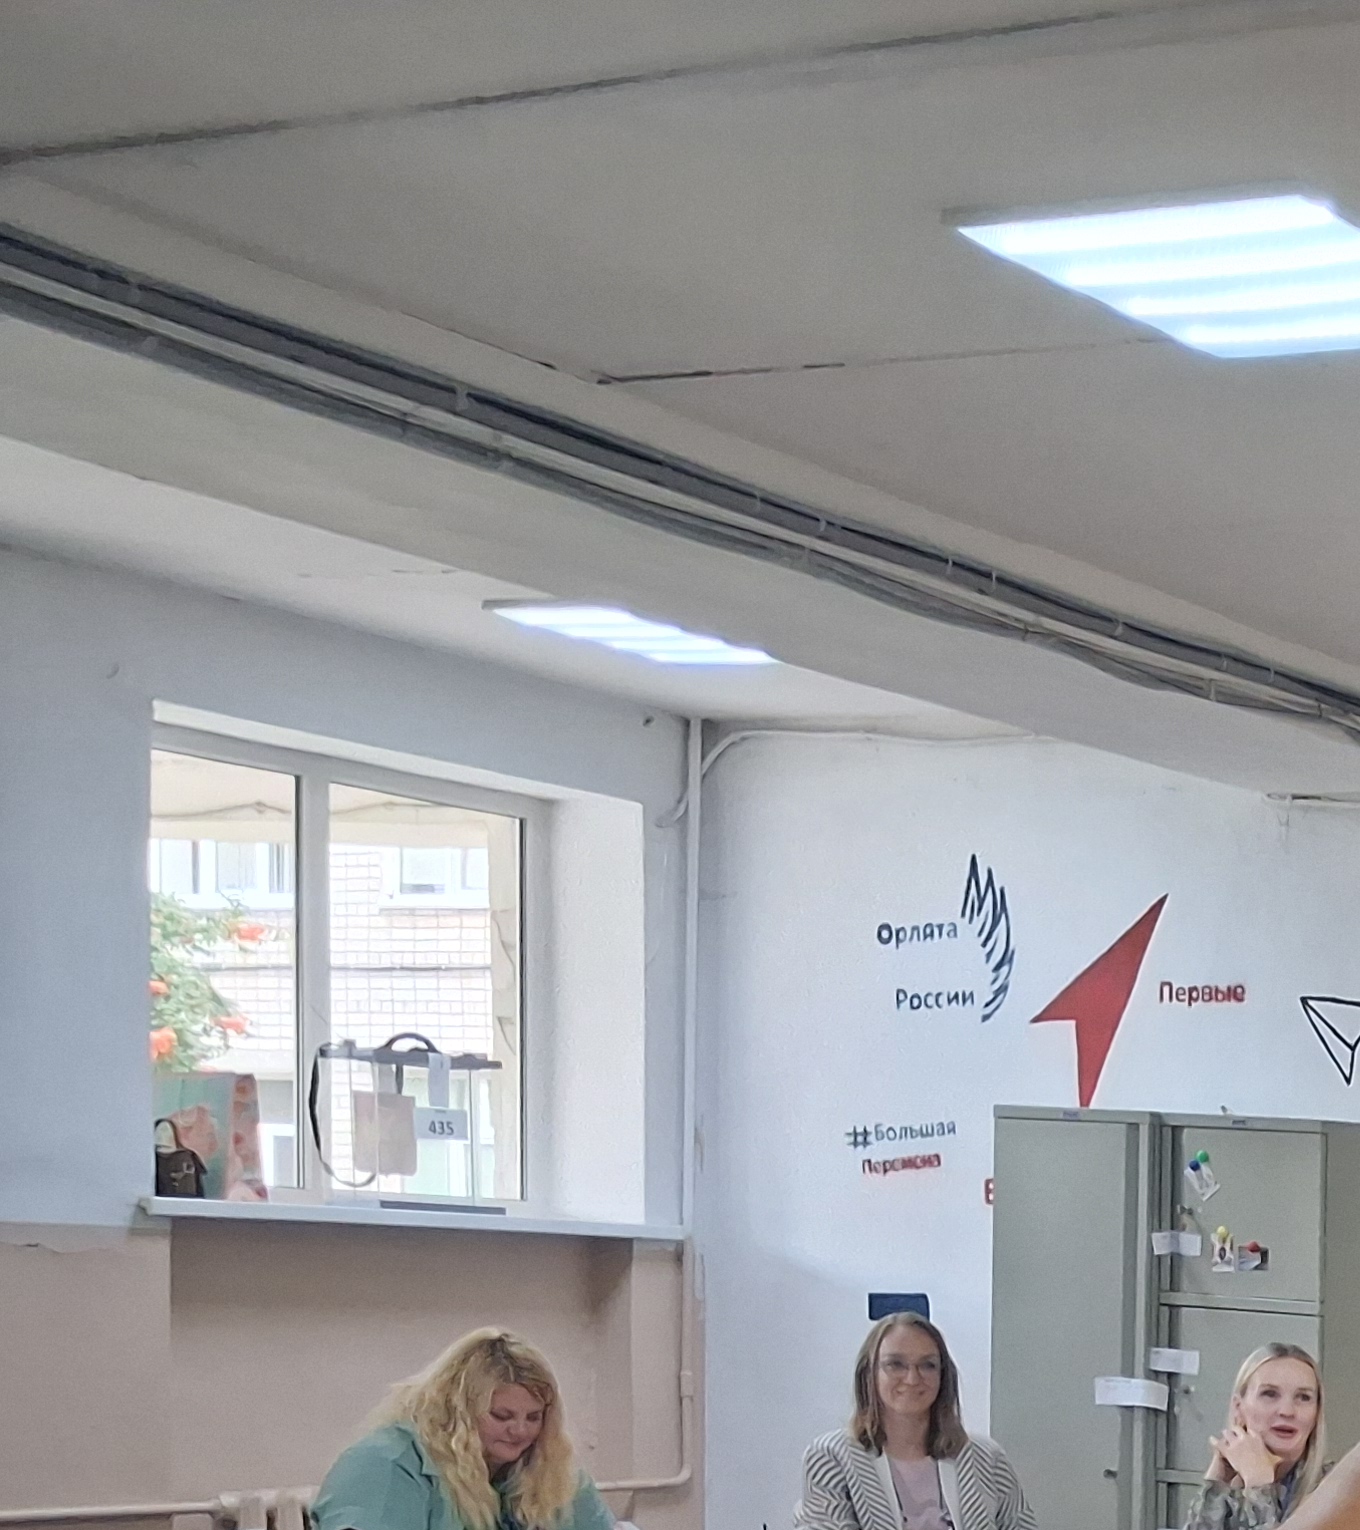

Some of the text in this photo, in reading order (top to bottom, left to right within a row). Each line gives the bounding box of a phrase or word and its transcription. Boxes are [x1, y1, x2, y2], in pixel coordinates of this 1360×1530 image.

[876, 921, 958, 949] Орлята
[895, 987, 975, 1011] России
[1159, 980, 1246, 1007] Первые
[428, 1120, 455, 1135] 435
